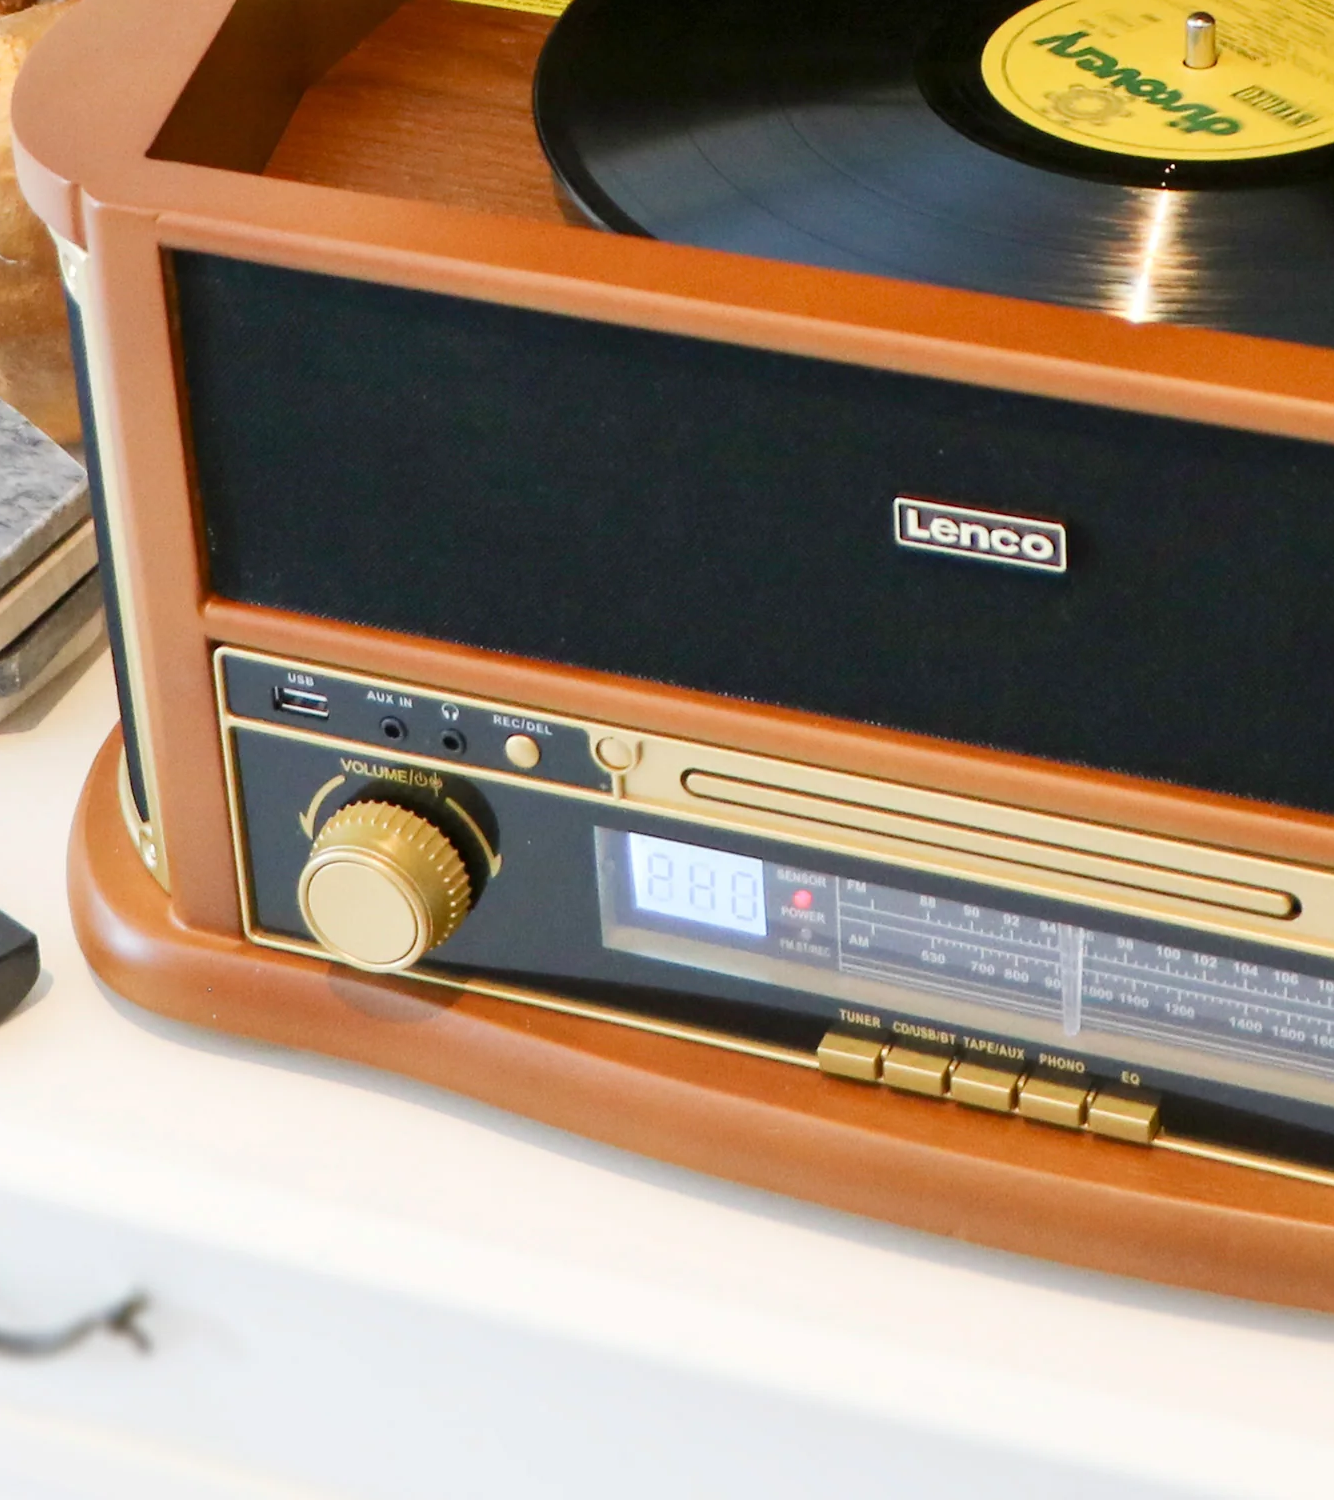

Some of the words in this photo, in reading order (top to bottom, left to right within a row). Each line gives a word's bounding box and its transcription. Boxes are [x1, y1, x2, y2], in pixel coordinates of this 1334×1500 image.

[1033, 30, 1241, 136] discovery
[906, 508, 1054, 560] Lenco
[288, 673, 314, 687] USB
[367, 690, 394, 706] AUX
[400, 697, 413, 709] IN
[493, 714, 554, 736] REC/DEL
[777, 868, 827, 888] SENSOR
[781, 905, 826, 924] POWER
[847, 879, 867, 893] FM
[920, 895, 936, 908] 88
[963, 905, 979, 918] 90
[1003, 914, 1020, 927] 92
[1039, 920, 1057, 934] 94
[1117, 937, 1134, 950] 98
[1157, 945, 1181, 960] 100
[1193, 953, 1217, 968] 102
[1233, 962, 1259, 977] 104
[1274, 971, 1299, 986] 106
[849, 934, 869, 948] AM
[971, 961, 995, 975] 700
[1004, 969, 1029, 983] 800
[1120, 993, 1149, 1008] 1100
[1165, 1003, 1195, 1019] 1200
[1229, 1016, 1263, 1033] 1400
[1273, 1025, 1305, 1041] 1500
[839, 1009, 881, 1028] TUNER
[893, 1021, 956, 1046] CD/USB/BT
[963, 1036, 1025, 1060] TAPE/AUX
[1039, 1053, 1085, 1073] PHONO
[1121, 1071, 1140, 1086] EQ
